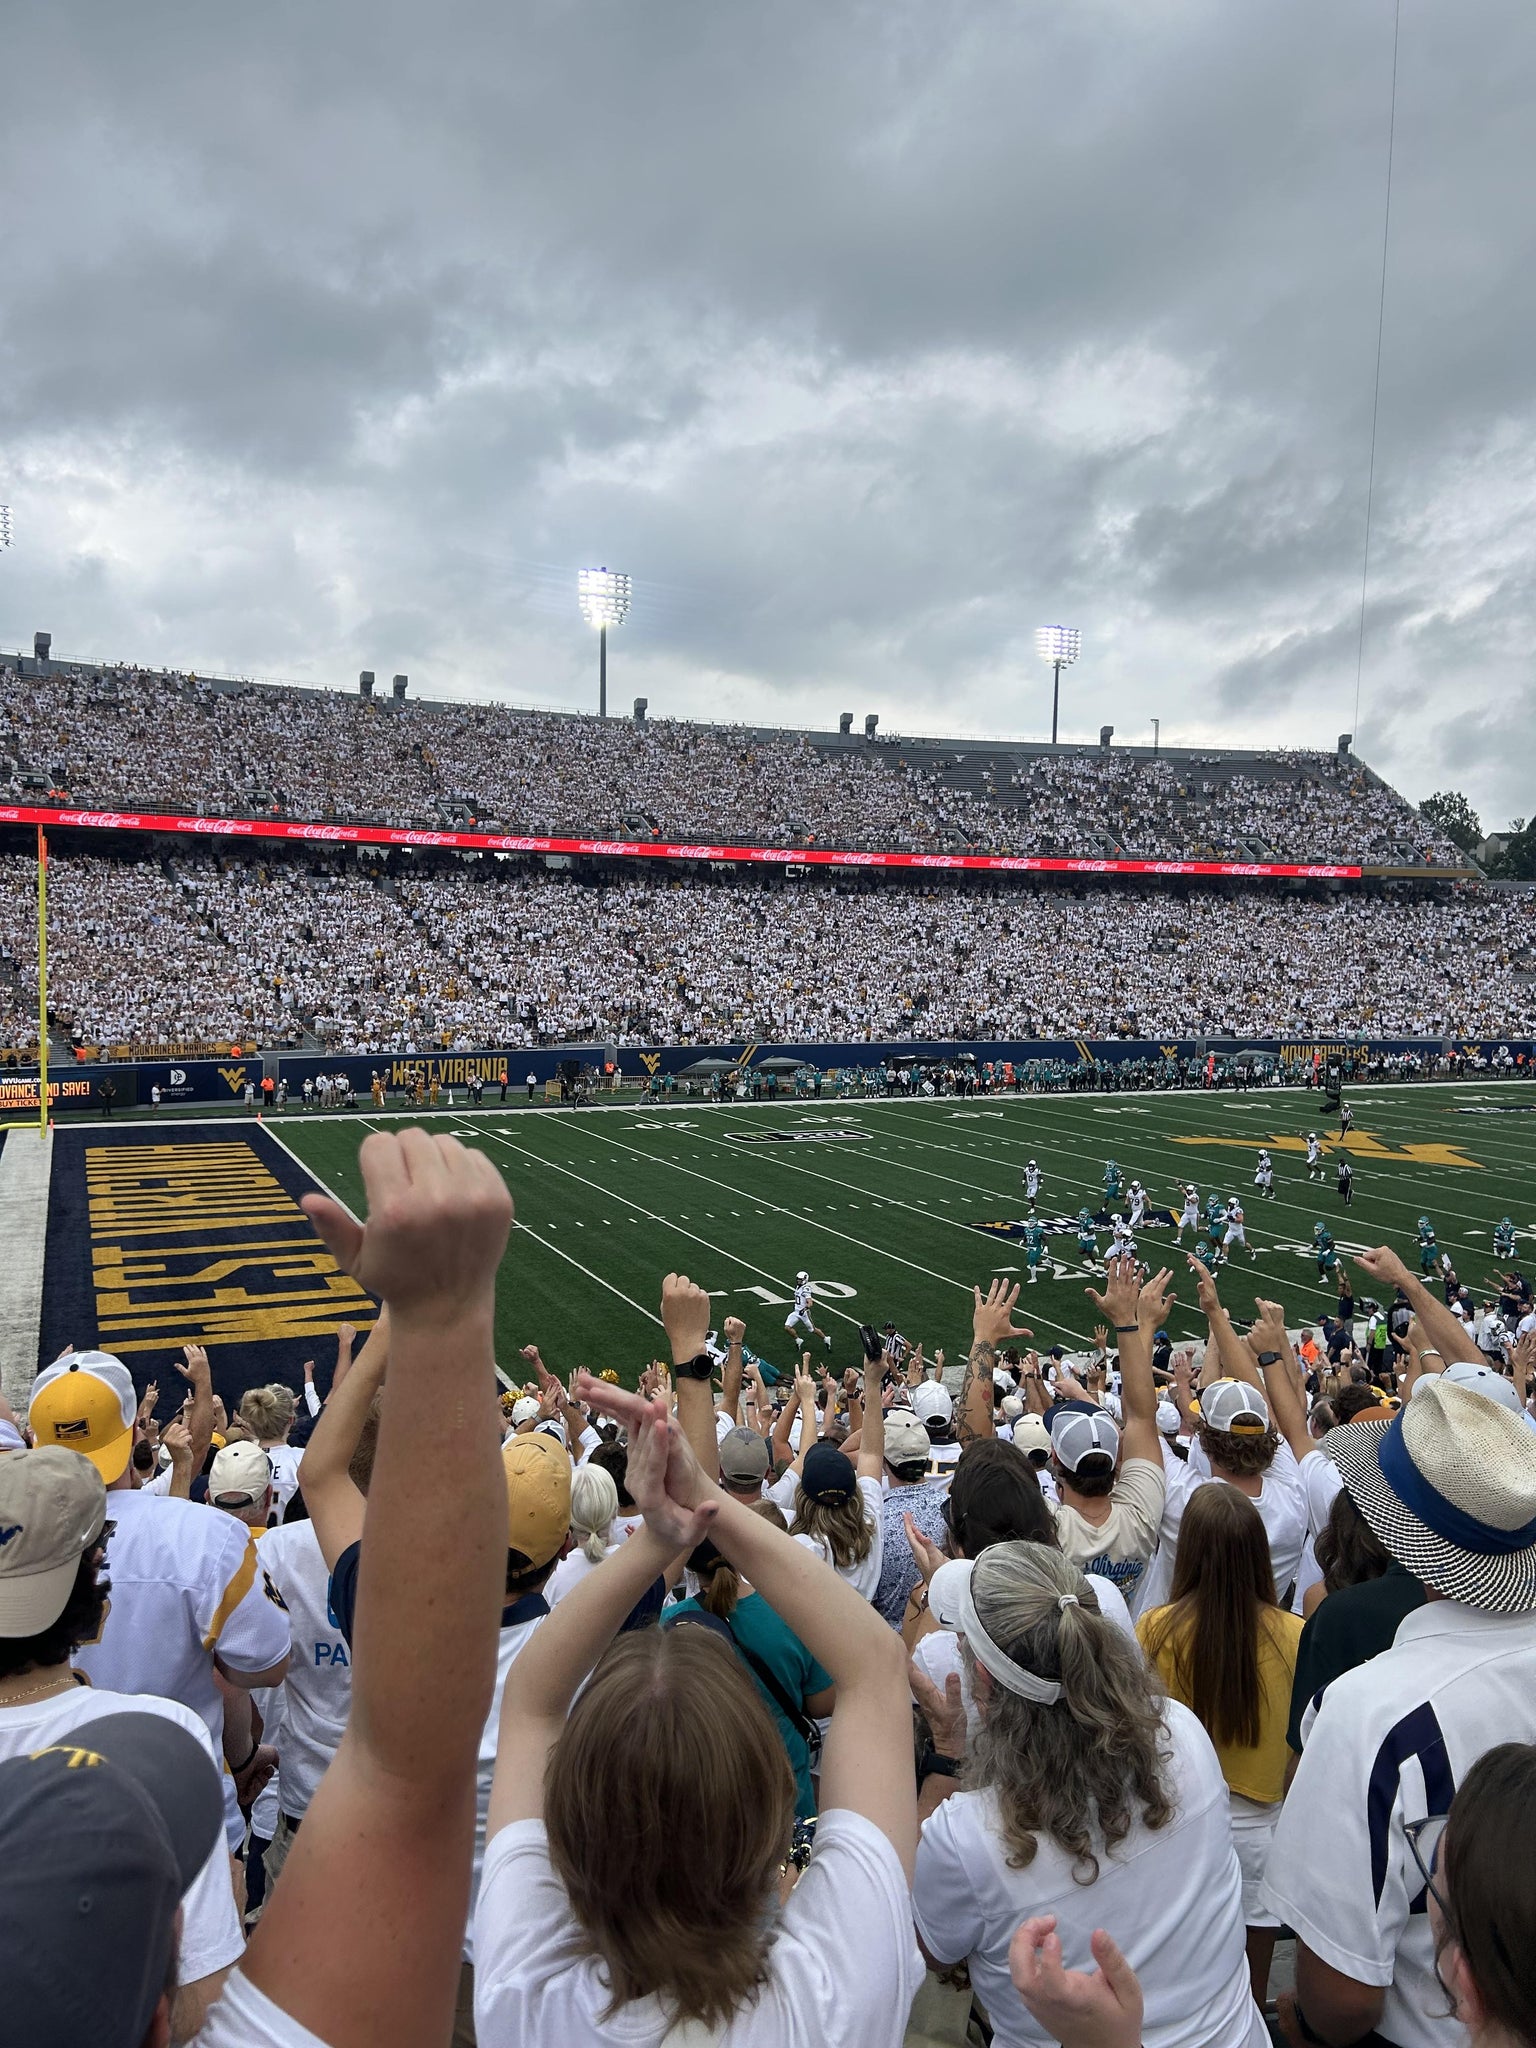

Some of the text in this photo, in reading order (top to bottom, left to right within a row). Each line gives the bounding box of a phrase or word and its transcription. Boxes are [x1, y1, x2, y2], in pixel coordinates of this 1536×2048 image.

[129, 1042, 217, 1056] MOUNTAINEER MANIACS
[392, 1058, 508, 1086] WEST VIRGINIA
[0, 1081, 90, 1099] DVANCE ND SAVE!
[733, 1280, 858, 1306] 10
[1091, 1553, 1144, 1579] Virginia
